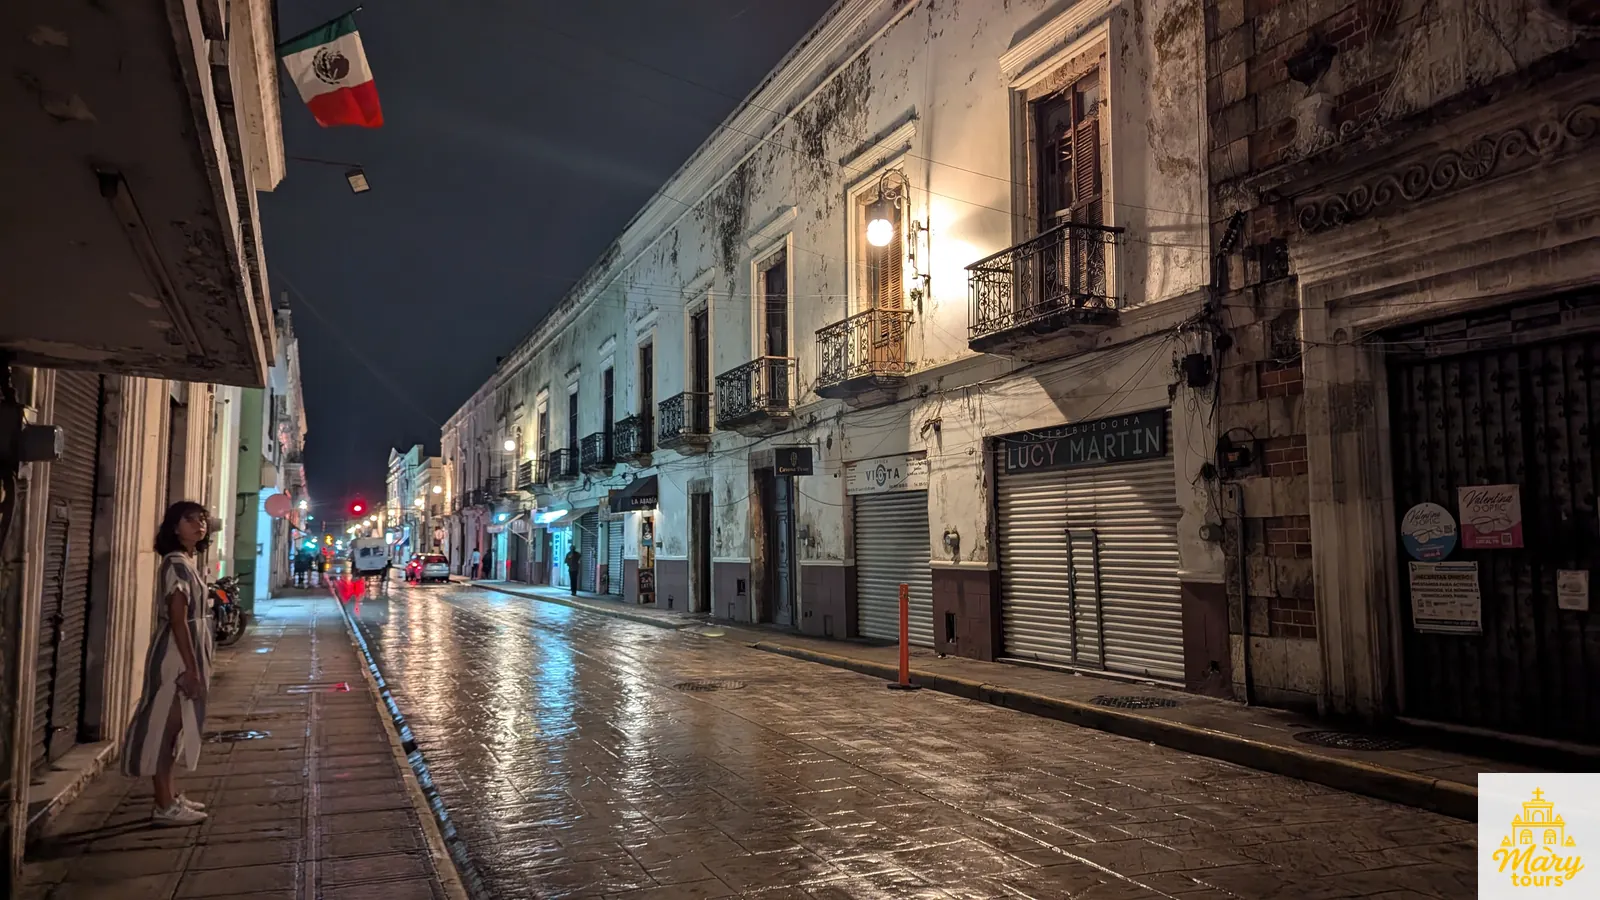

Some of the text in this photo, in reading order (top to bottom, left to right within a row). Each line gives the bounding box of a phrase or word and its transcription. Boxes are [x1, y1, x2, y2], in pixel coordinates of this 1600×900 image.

[1022, 416, 1140, 441] DISTRIBUIDORA
[1007, 426, 1160, 469] LUCY MARTIN
